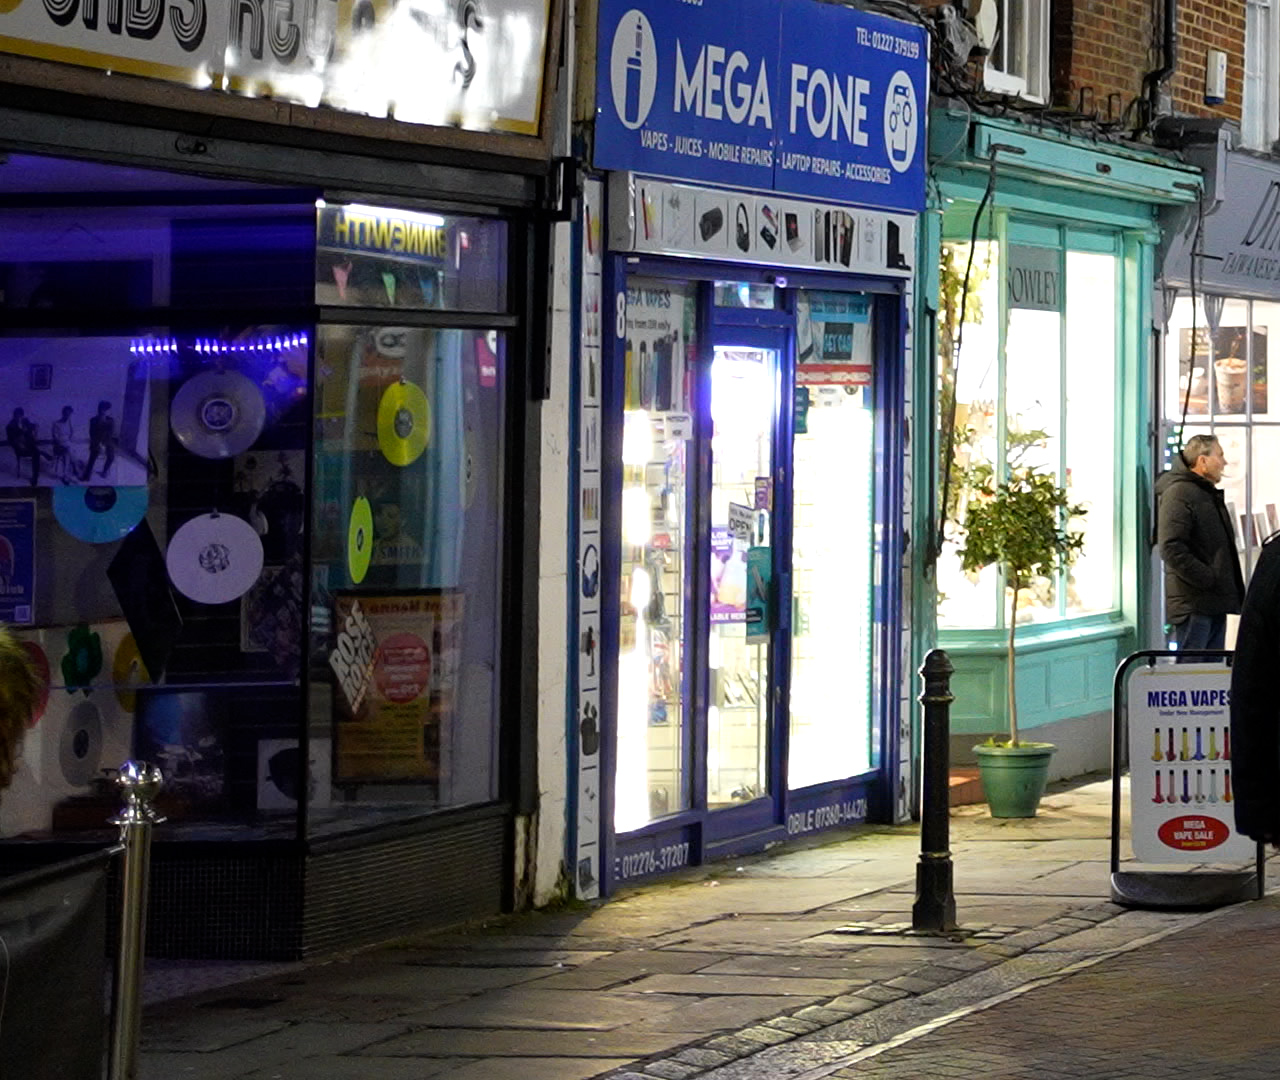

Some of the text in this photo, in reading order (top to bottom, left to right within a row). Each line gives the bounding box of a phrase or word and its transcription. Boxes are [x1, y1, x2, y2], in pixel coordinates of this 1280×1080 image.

[872, 31, 893, 52] 01227
[673, 37, 870, 147] MEGA FONE
[640, 129, 891, 184] VAPES JUICES MOBILE REPAIRS LAPTOP REPAIRS ACCESSORIES
[1222, 252, 1278, 279] TAIWANESE
[1148, 689, 1232, 708] MEGA VAPES
